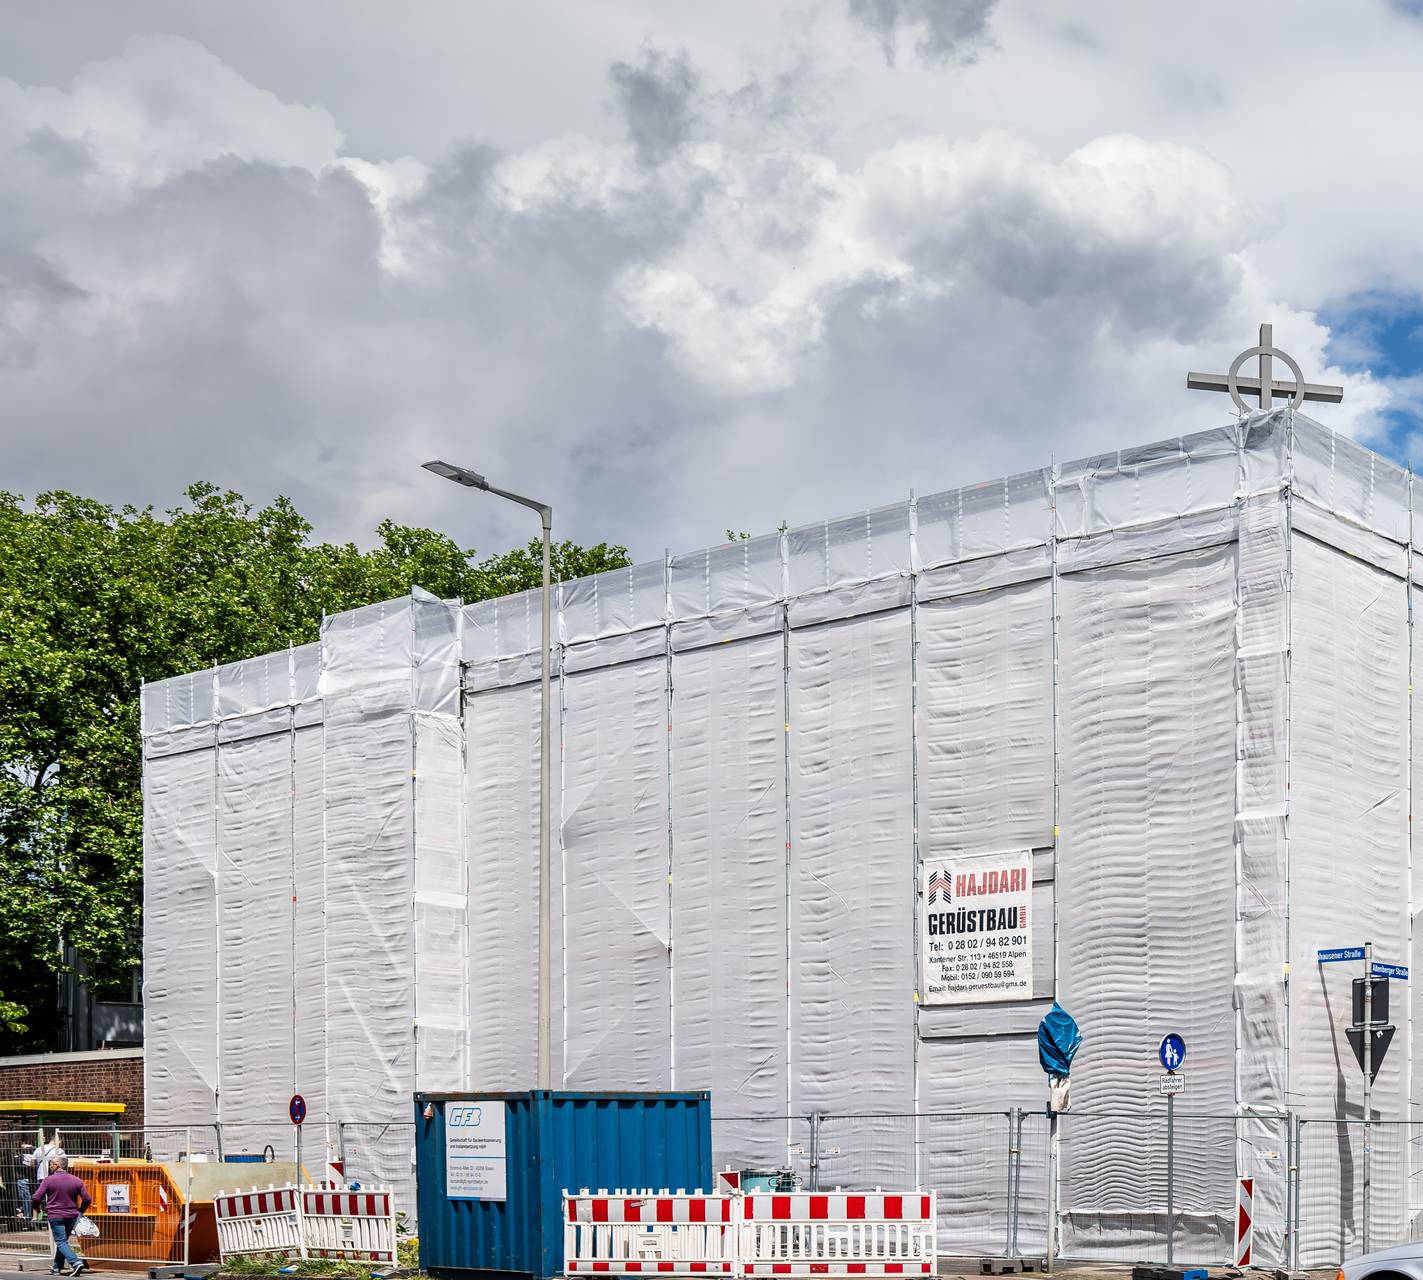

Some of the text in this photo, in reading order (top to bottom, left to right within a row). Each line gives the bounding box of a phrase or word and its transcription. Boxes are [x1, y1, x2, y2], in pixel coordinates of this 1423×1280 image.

[956, 868, 1027, 897] HAJDARI
[928, 906, 1018, 936] GERÜSTBAU
[929, 942, 944, 951] Tel:
[948, 941, 953, 950] 0
[956, 940, 965, 949] 28
[967, 939, 978, 949] 02
[986, 938, 996, 947] 94
[998, 936, 1010, 947] 82
[1011, 935, 1027, 945] 901
[1008, 950, 1027, 959] Alpen
[1344, 950, 1362, 959] Straße
[449, 1107, 482, 1127] GFB
